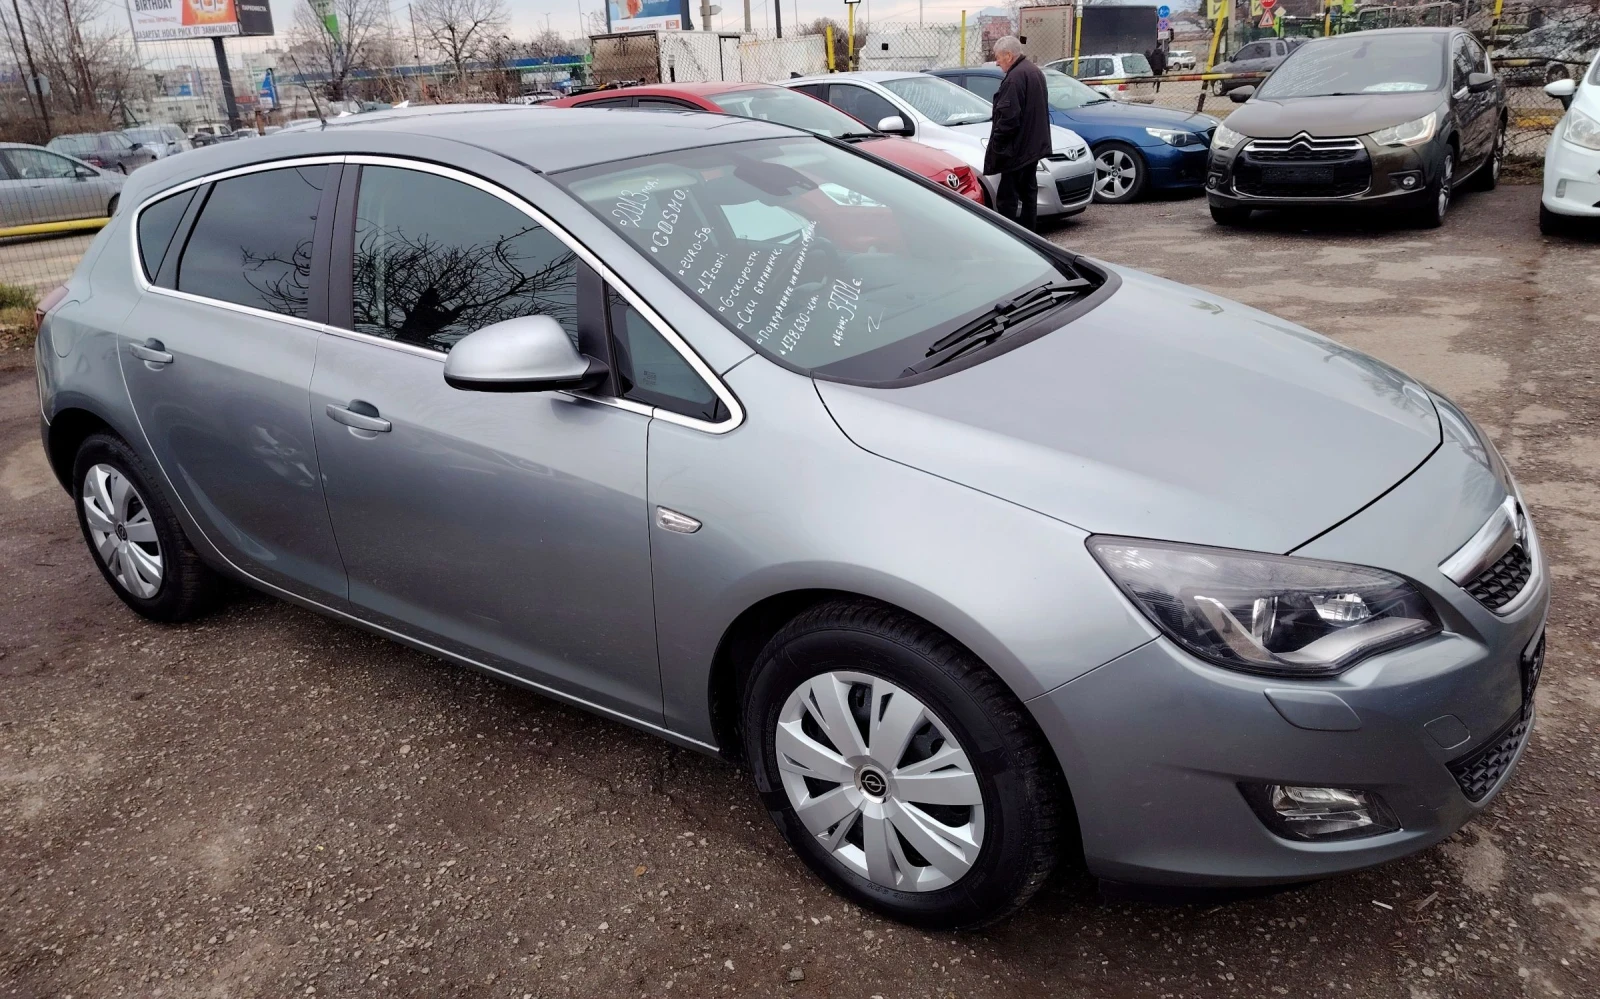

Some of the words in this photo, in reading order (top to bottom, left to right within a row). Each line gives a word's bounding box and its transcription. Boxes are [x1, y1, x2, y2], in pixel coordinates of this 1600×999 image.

[134, 0, 173, 11] BIRTHDAY
[162, 28, 177, 37] НОСИ
[179, 27, 192, 36] РИСК
[193, 26, 201, 35] ОТ
[201, 24, 238, 34] ЗАВИСИМОСТ
